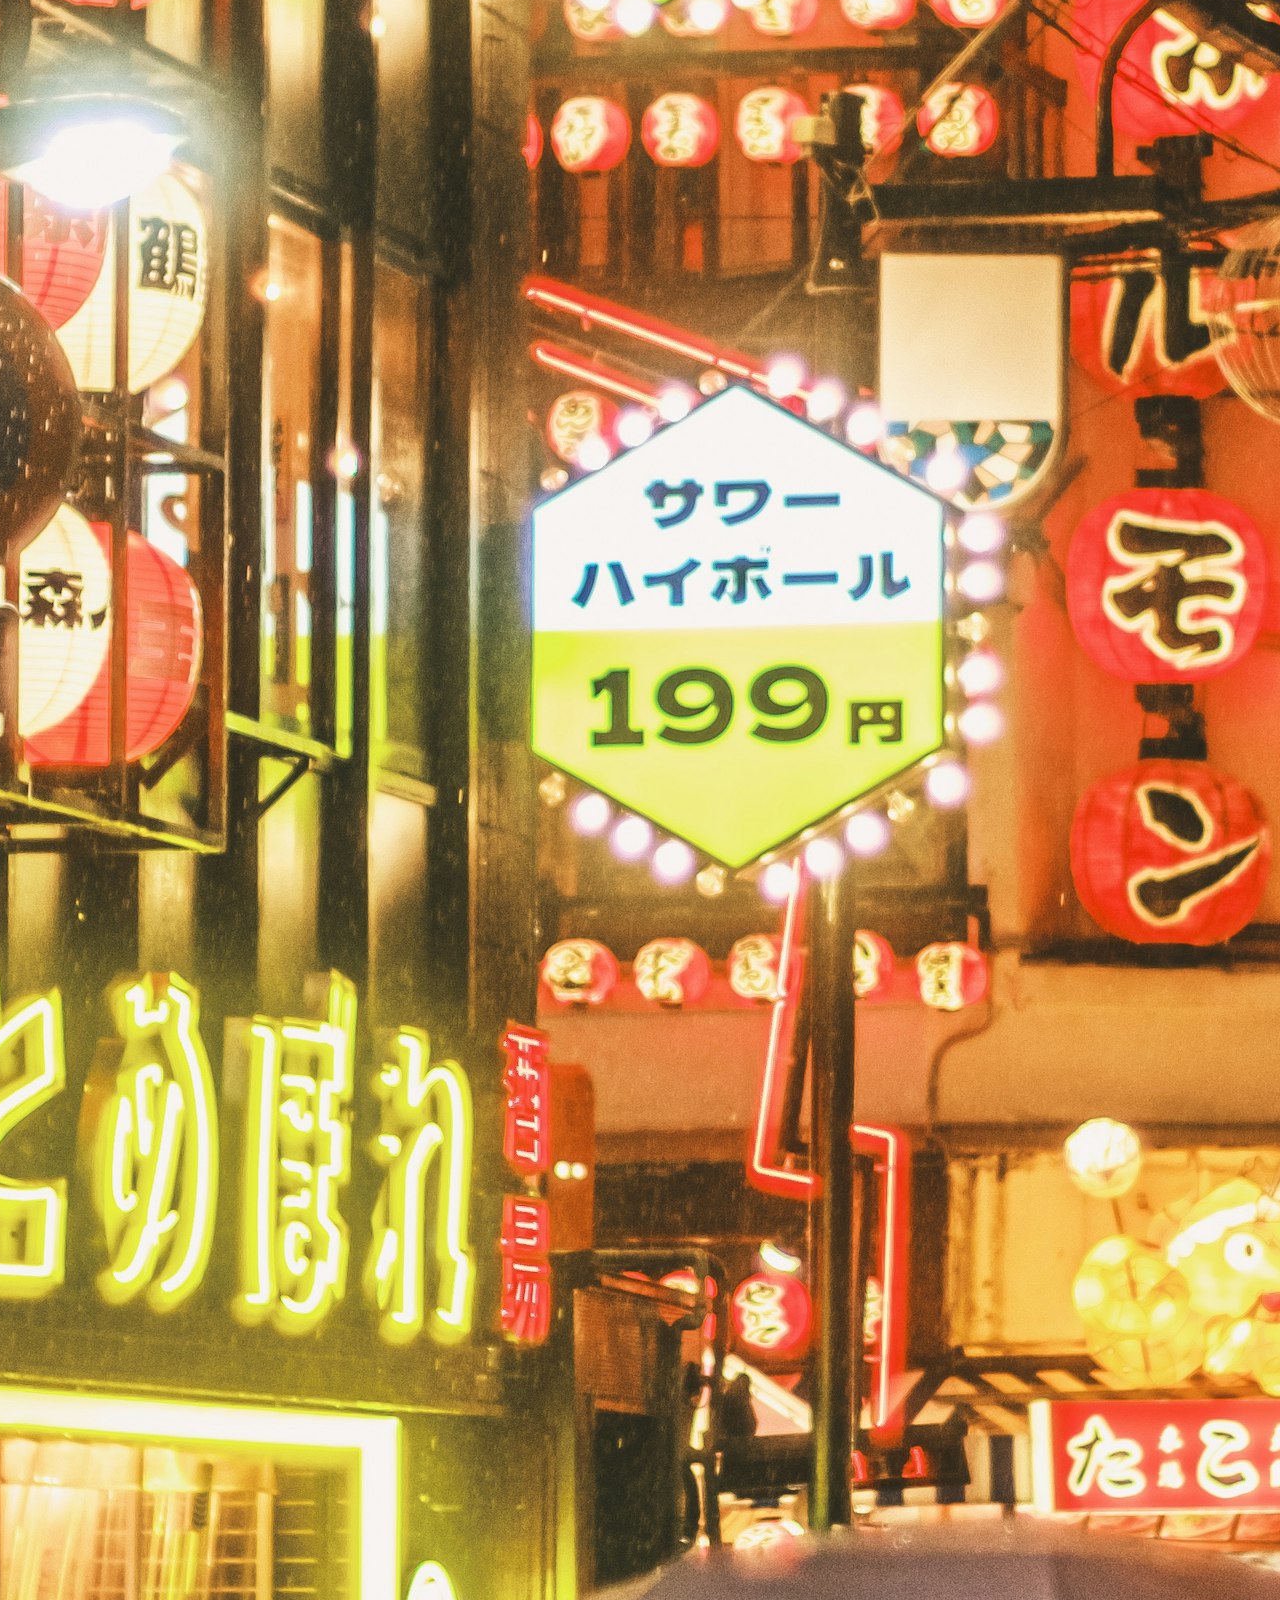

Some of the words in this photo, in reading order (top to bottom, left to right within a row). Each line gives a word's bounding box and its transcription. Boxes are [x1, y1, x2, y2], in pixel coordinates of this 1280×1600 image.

[644, 480, 842, 528] サワー
[572, 550, 911, 608] ハイボール
[589, 664, 905, 748] 199円
